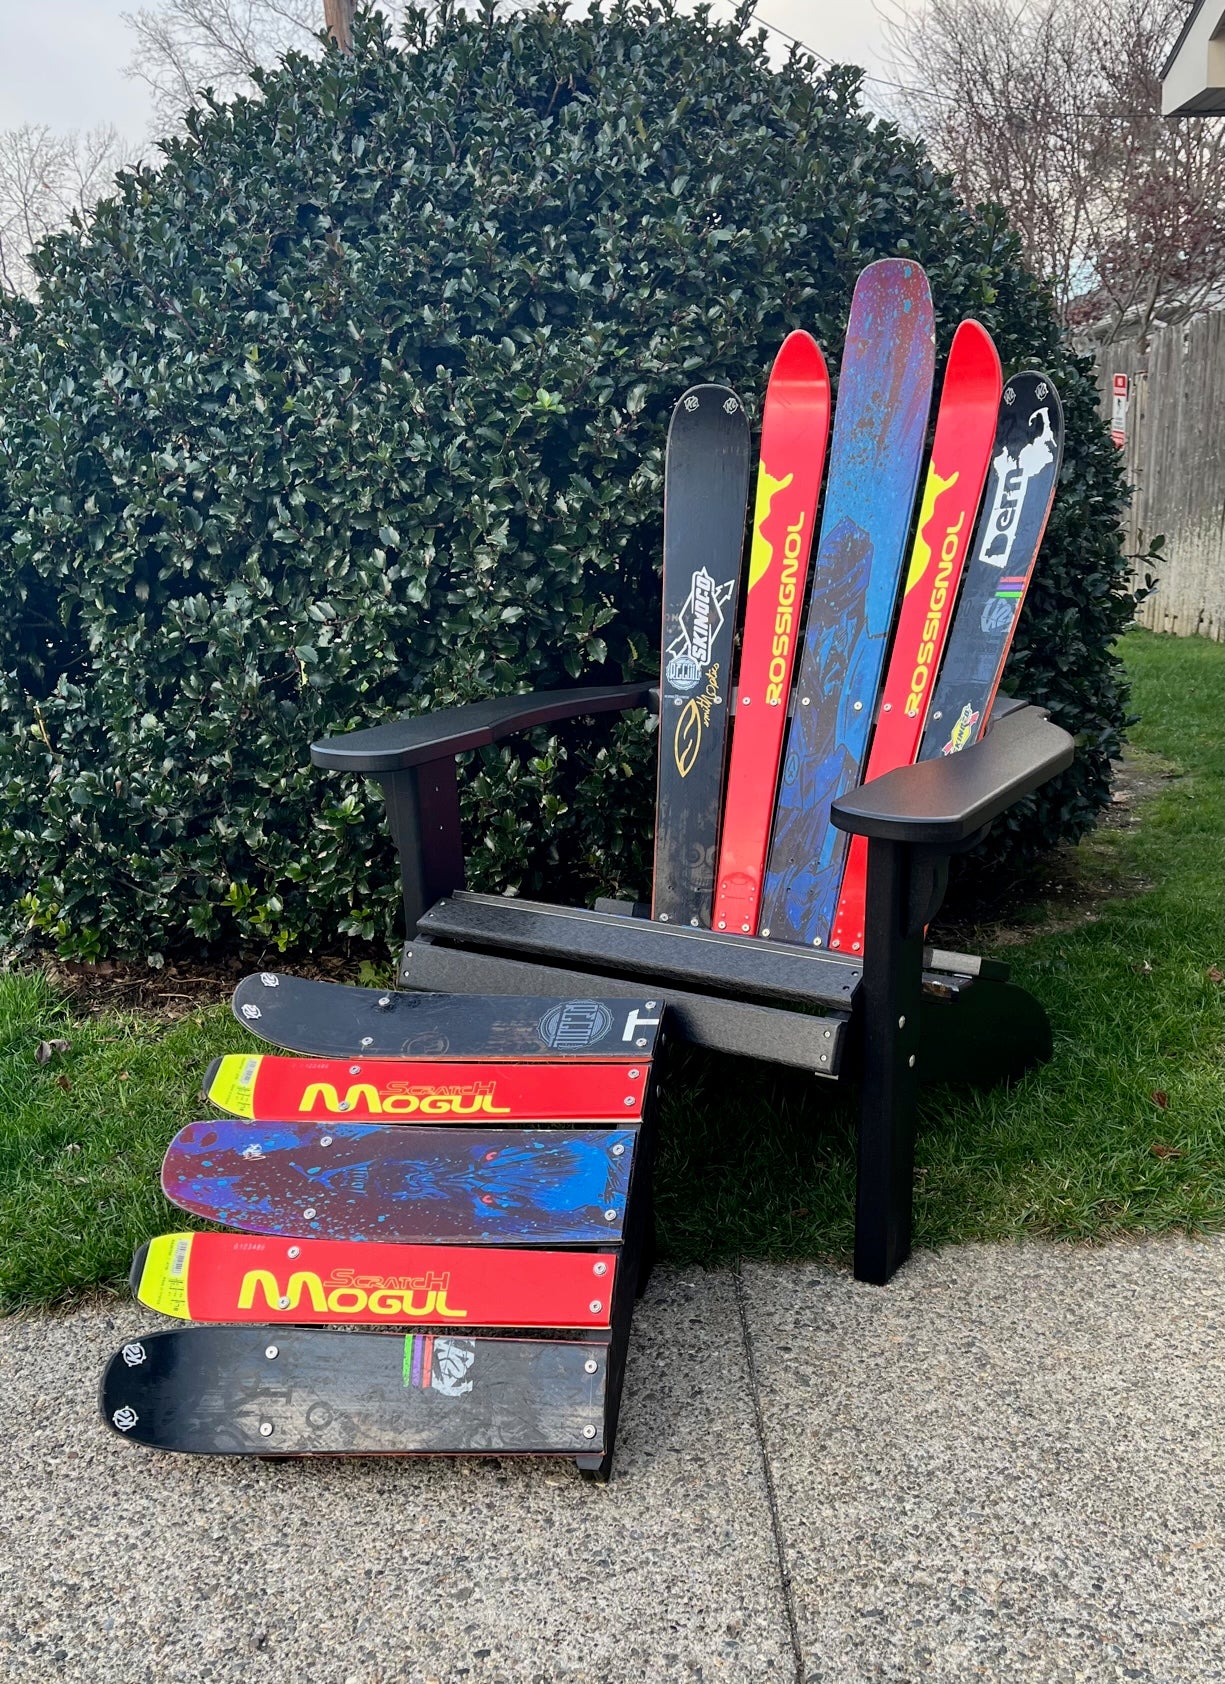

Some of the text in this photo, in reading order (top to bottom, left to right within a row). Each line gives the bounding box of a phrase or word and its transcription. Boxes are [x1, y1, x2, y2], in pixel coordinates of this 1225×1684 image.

[985, 468, 1023, 559] bern
[765, 511, 805, 706] ROSSIGNOL
[904, 510, 966, 717] ROSSIGNOL
[553, 1004, 599, 1048] RECOIL
